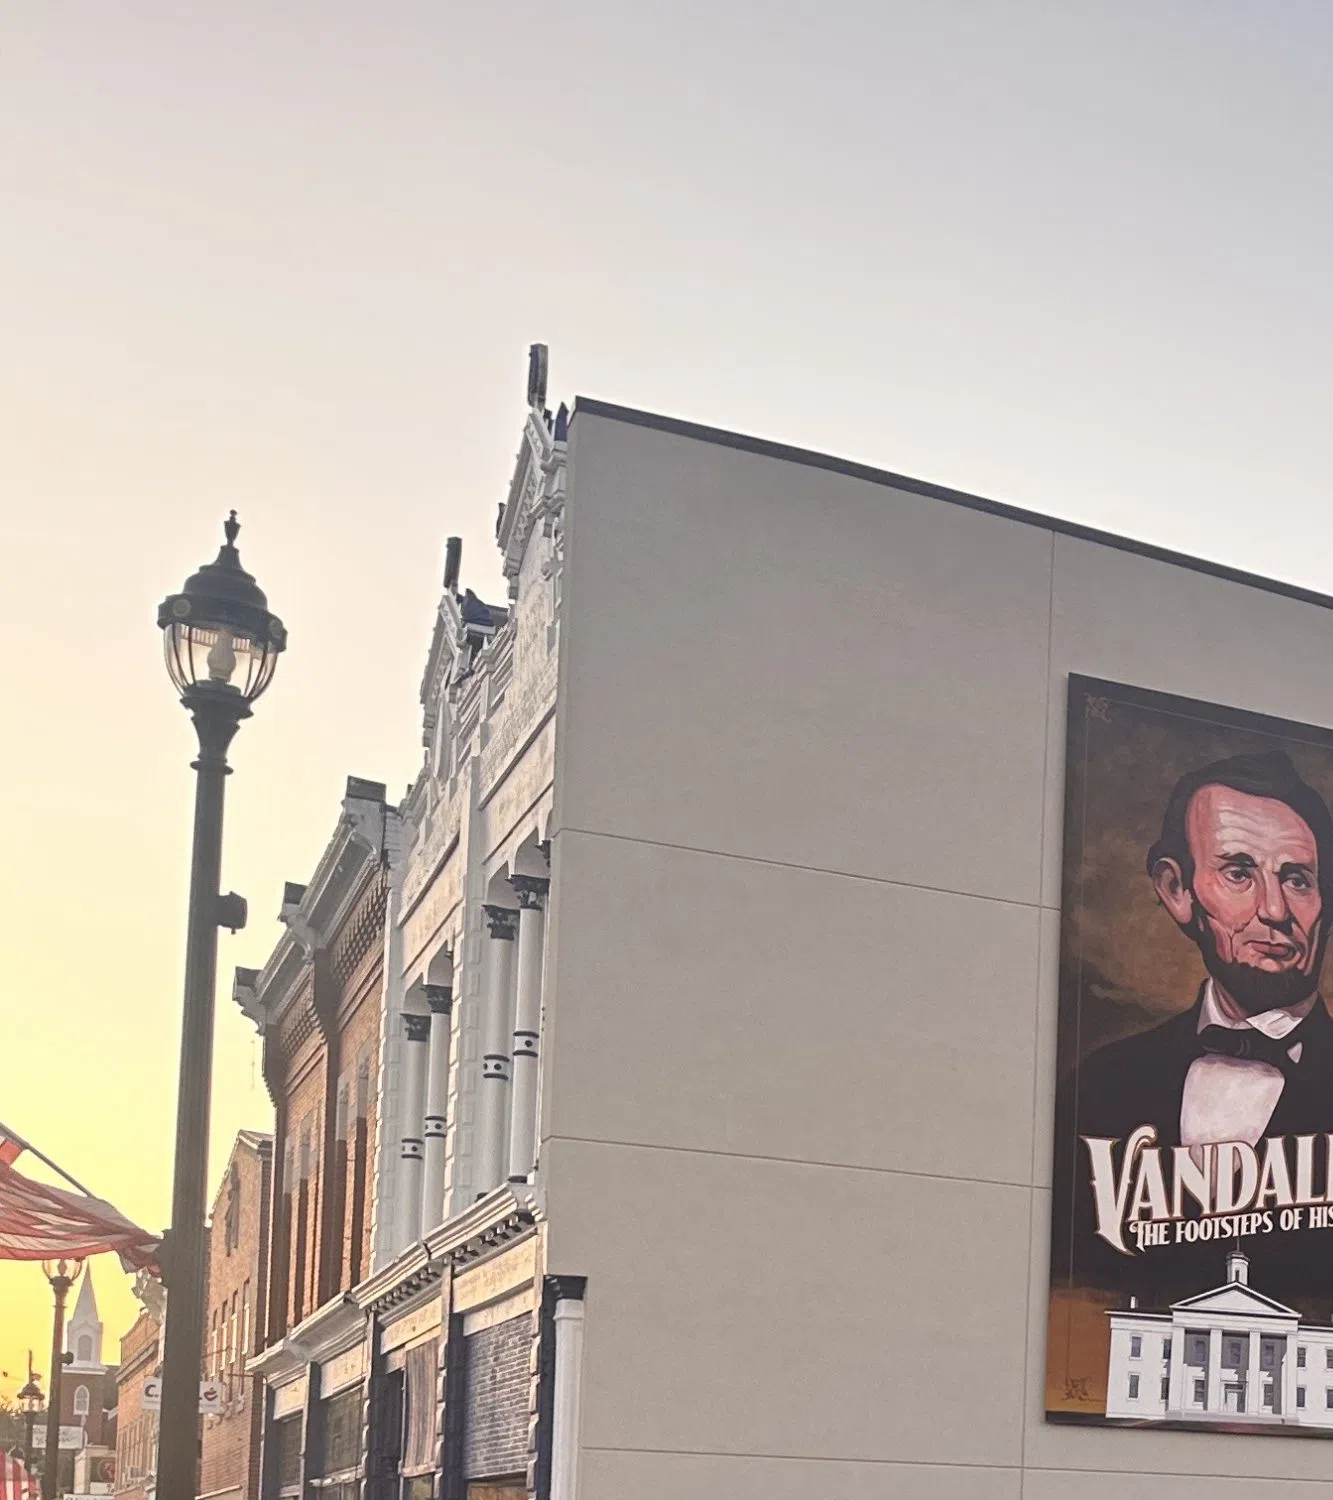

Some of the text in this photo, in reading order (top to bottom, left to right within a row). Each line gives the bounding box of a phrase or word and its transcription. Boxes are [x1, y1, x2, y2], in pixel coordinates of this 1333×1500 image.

[1129, 1219, 1170, 1252] THE
[1175, 1210, 1274, 1244] FOOTSTEPS
[1279, 1208, 1303, 1231] OF
